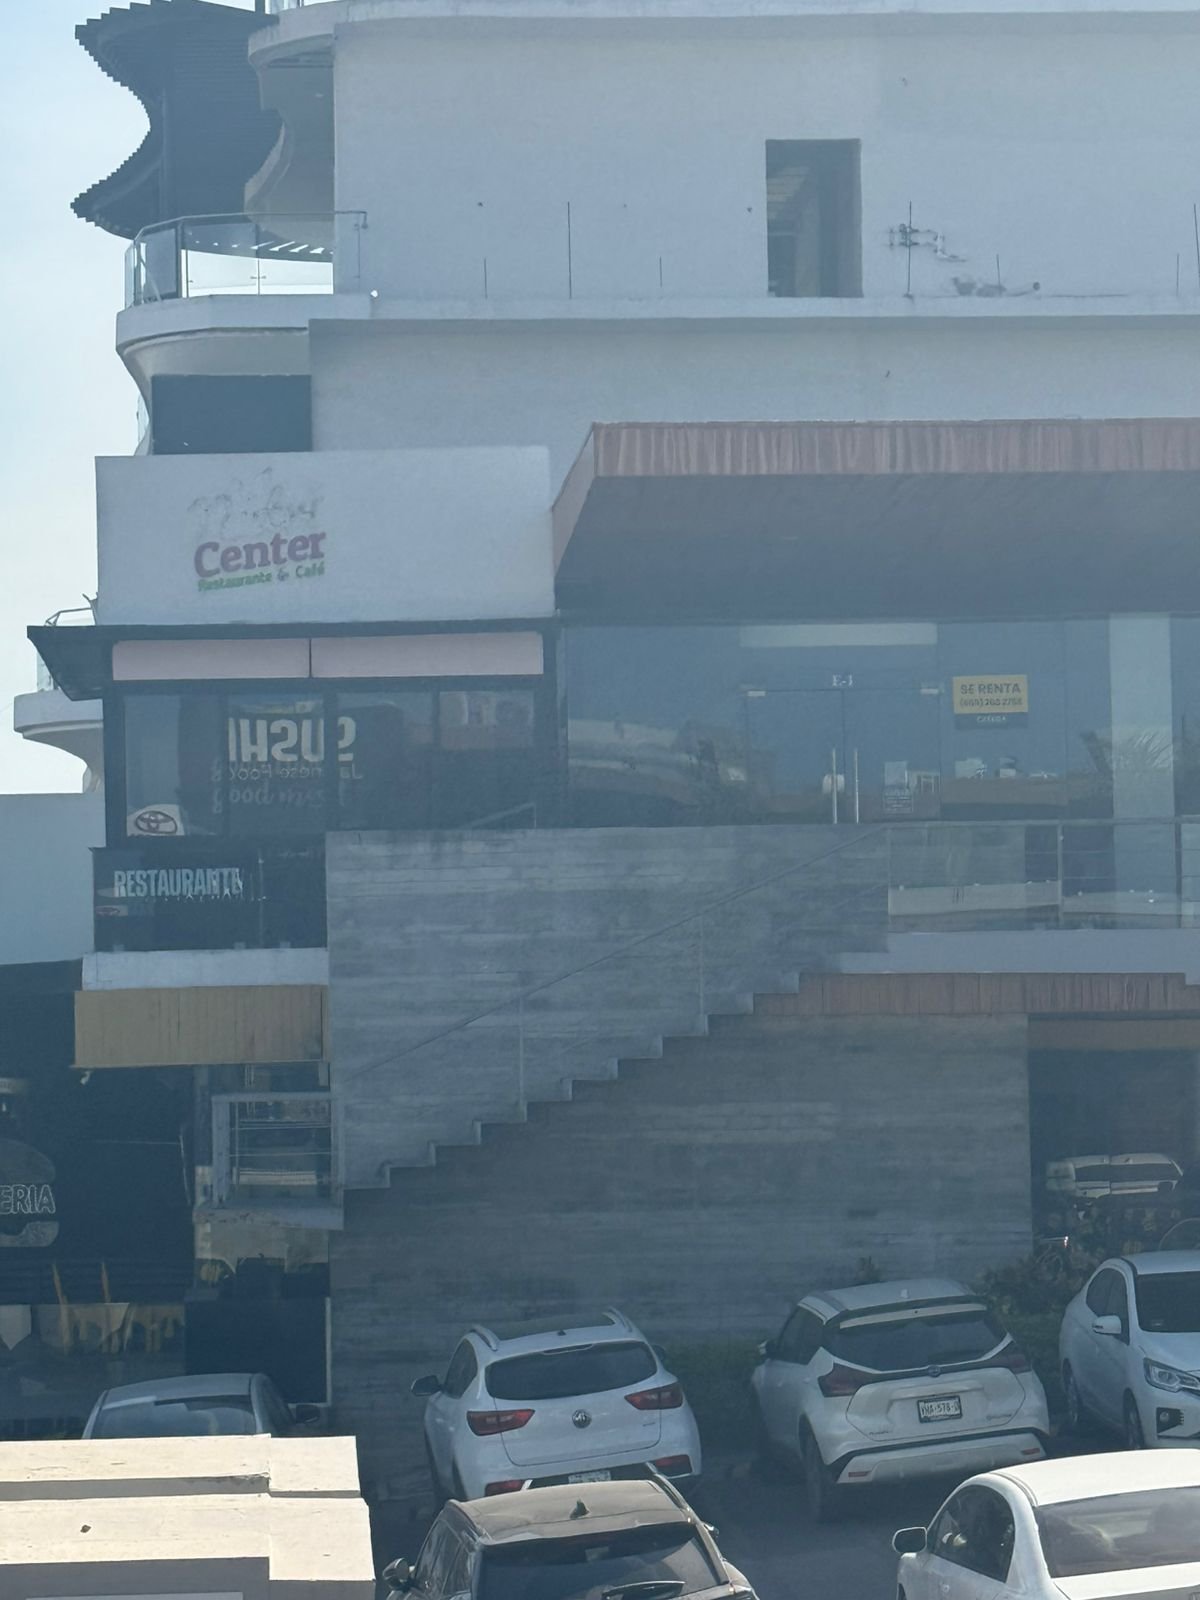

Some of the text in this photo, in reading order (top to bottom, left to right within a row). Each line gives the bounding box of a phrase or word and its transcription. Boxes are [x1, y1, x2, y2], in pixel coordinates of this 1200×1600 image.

[195, 532, 326, 578] Center
[295, 561, 326, 579] Café
[960, 682, 1022, 695] SE RENTA
[114, 868, 243, 897] RESTAURANTE
[0, 1184, 56, 1214] ERIA
